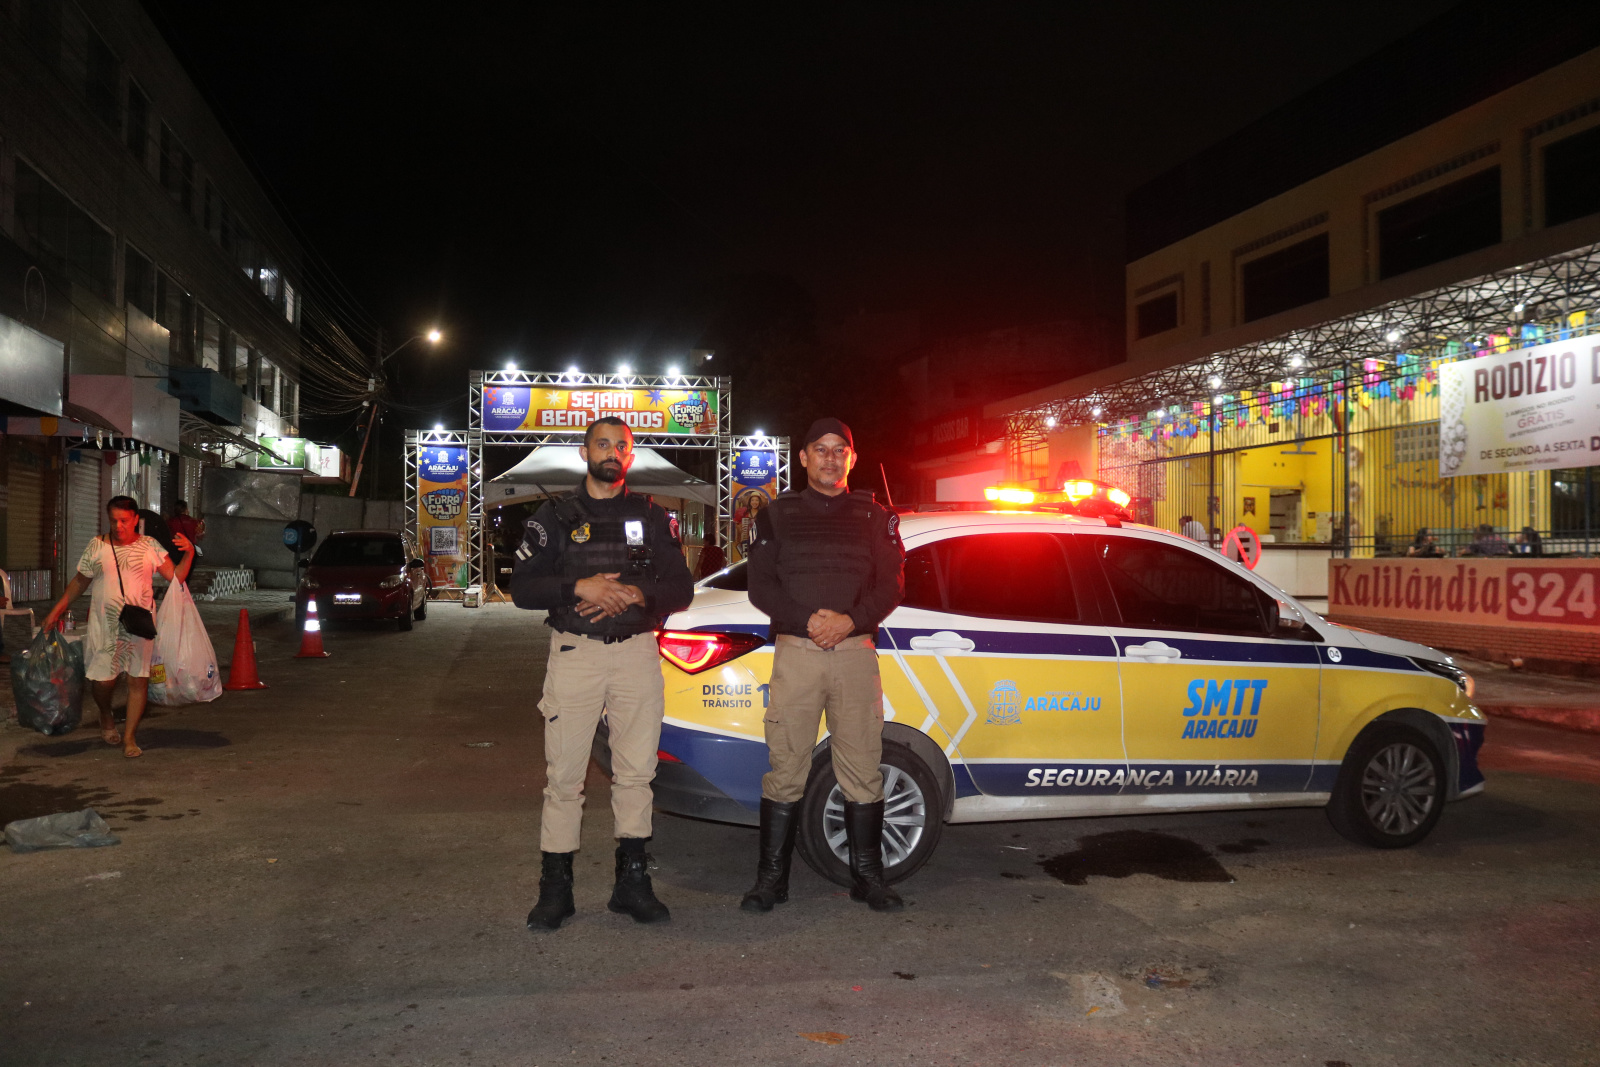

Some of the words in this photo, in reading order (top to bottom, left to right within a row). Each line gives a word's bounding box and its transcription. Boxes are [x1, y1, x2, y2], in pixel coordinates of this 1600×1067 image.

[1474, 352, 1576, 403] RODÍZIO
[571, 391, 633, 412] SEJAM
[491, 407, 525, 415] ARACAJU
[674, 413, 704, 424] CAJU
[1480, 450, 1493, 460] DE
[1494, 445, 1541, 458] SEGUNDA
[1543, 443, 1551, 452] A
[1553, 440, 1586, 452] SEXTA
[427, 504, 460, 515] CAJU
[1332, 563, 1503, 614] Kalilândia
[1510, 572, 1597, 619] 324
[1329, 650, 1340, 658] 04
[702, 684, 752, 698] DISQUE
[1182, 679, 1268, 718] SMTT
[702, 697, 752, 709] TRÂNSITO
[1024, 696, 1101, 711] ARACAJU
[1181, 718, 1259, 739] ARACAJU
[1024, 768, 1174, 790] SEGURANÇA
[1184, 764, 1259, 787] VIÁRIA
